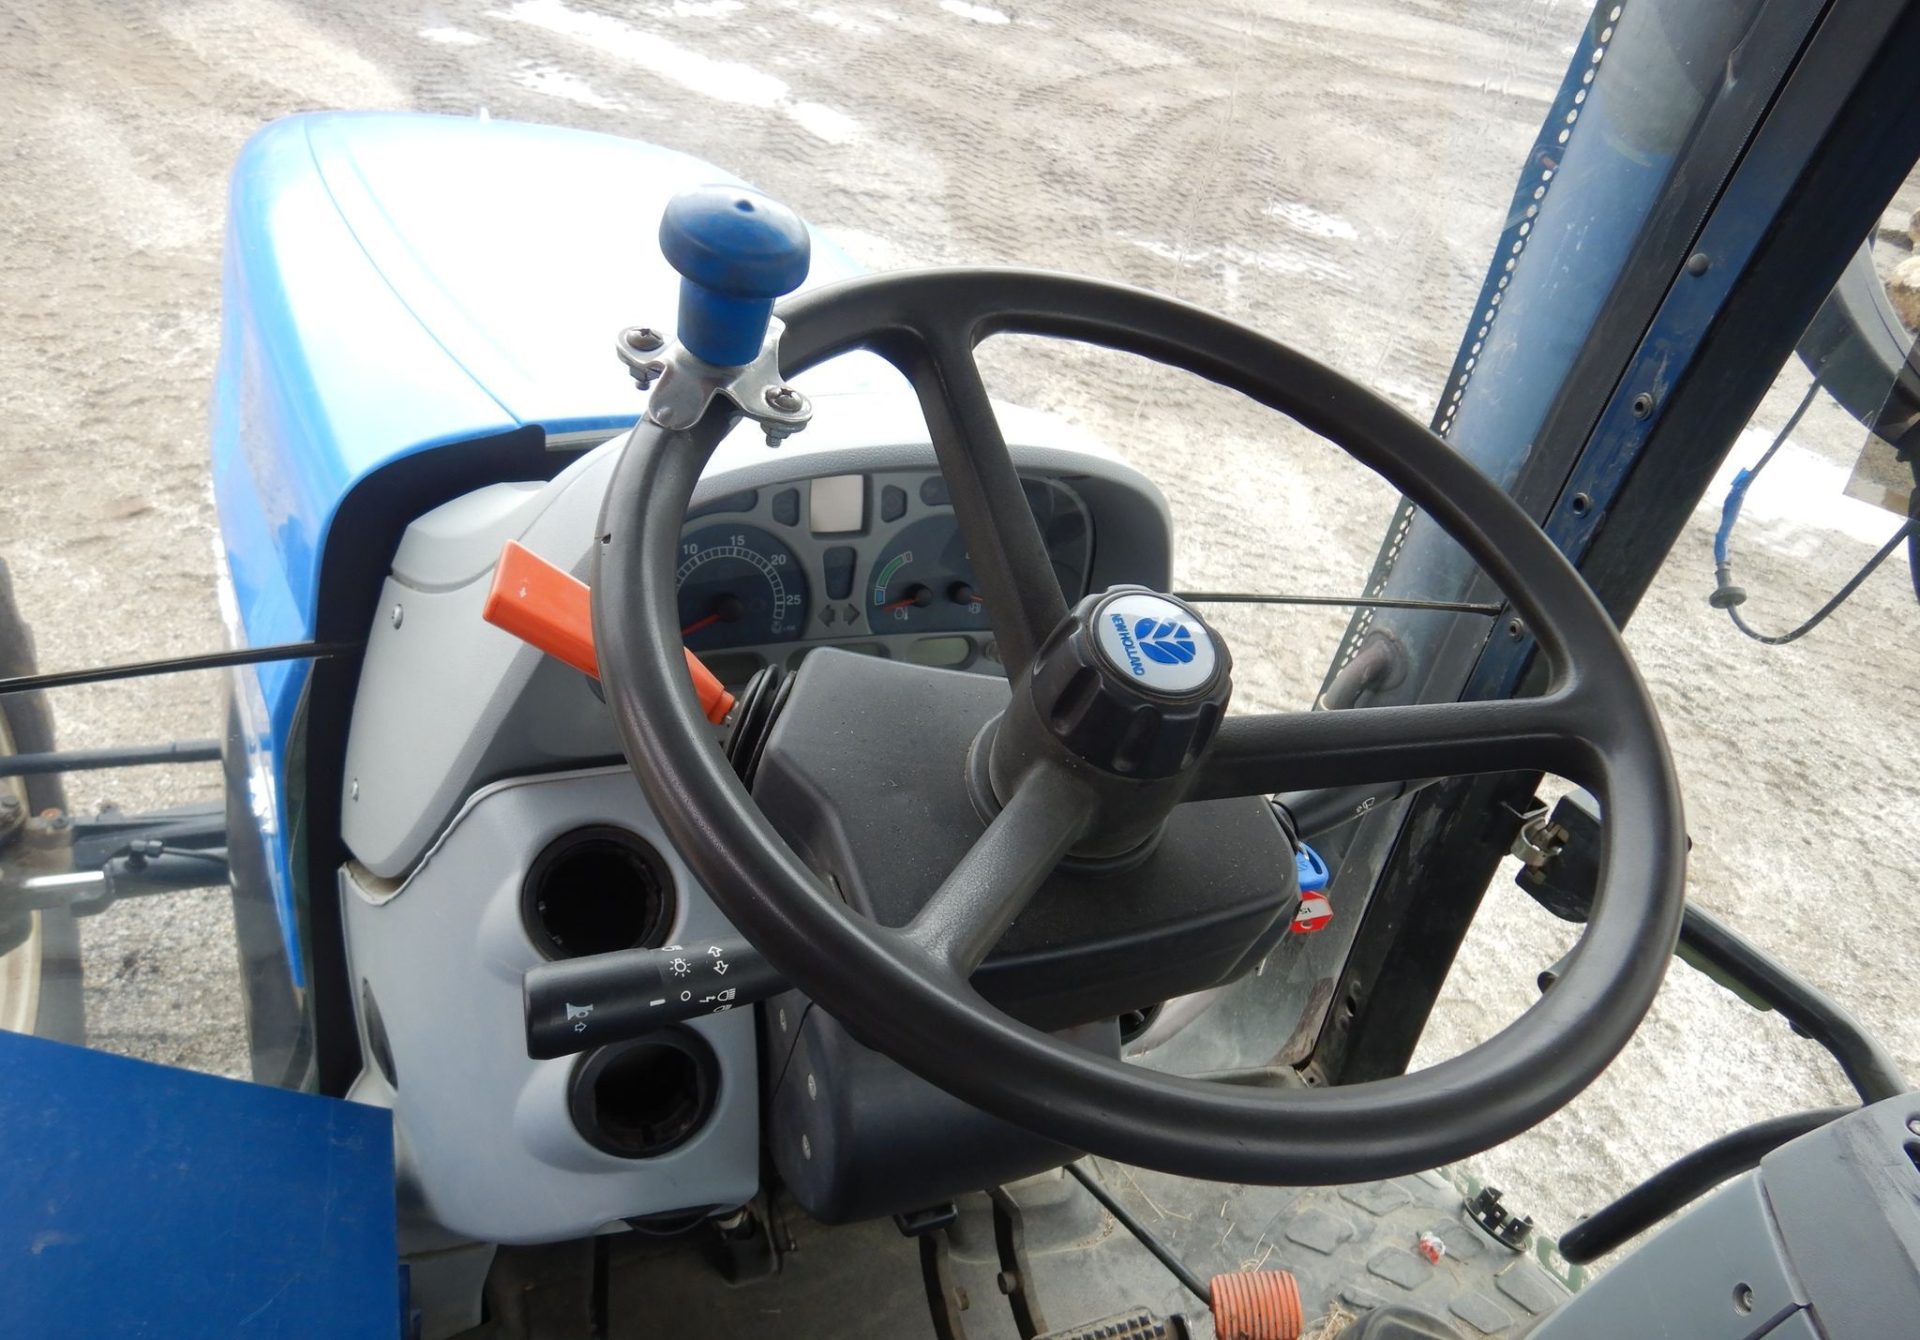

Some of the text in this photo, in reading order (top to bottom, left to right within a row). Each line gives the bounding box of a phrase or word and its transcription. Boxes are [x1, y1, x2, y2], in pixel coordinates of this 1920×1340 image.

[730, 535, 745, 546] 15
[683, 543, 698, 555] 10
[771, 554, 787, 566] 20
[786, 595, 801, 606] 25
[1110, 613, 1145, 676] NEW HOLLAND
